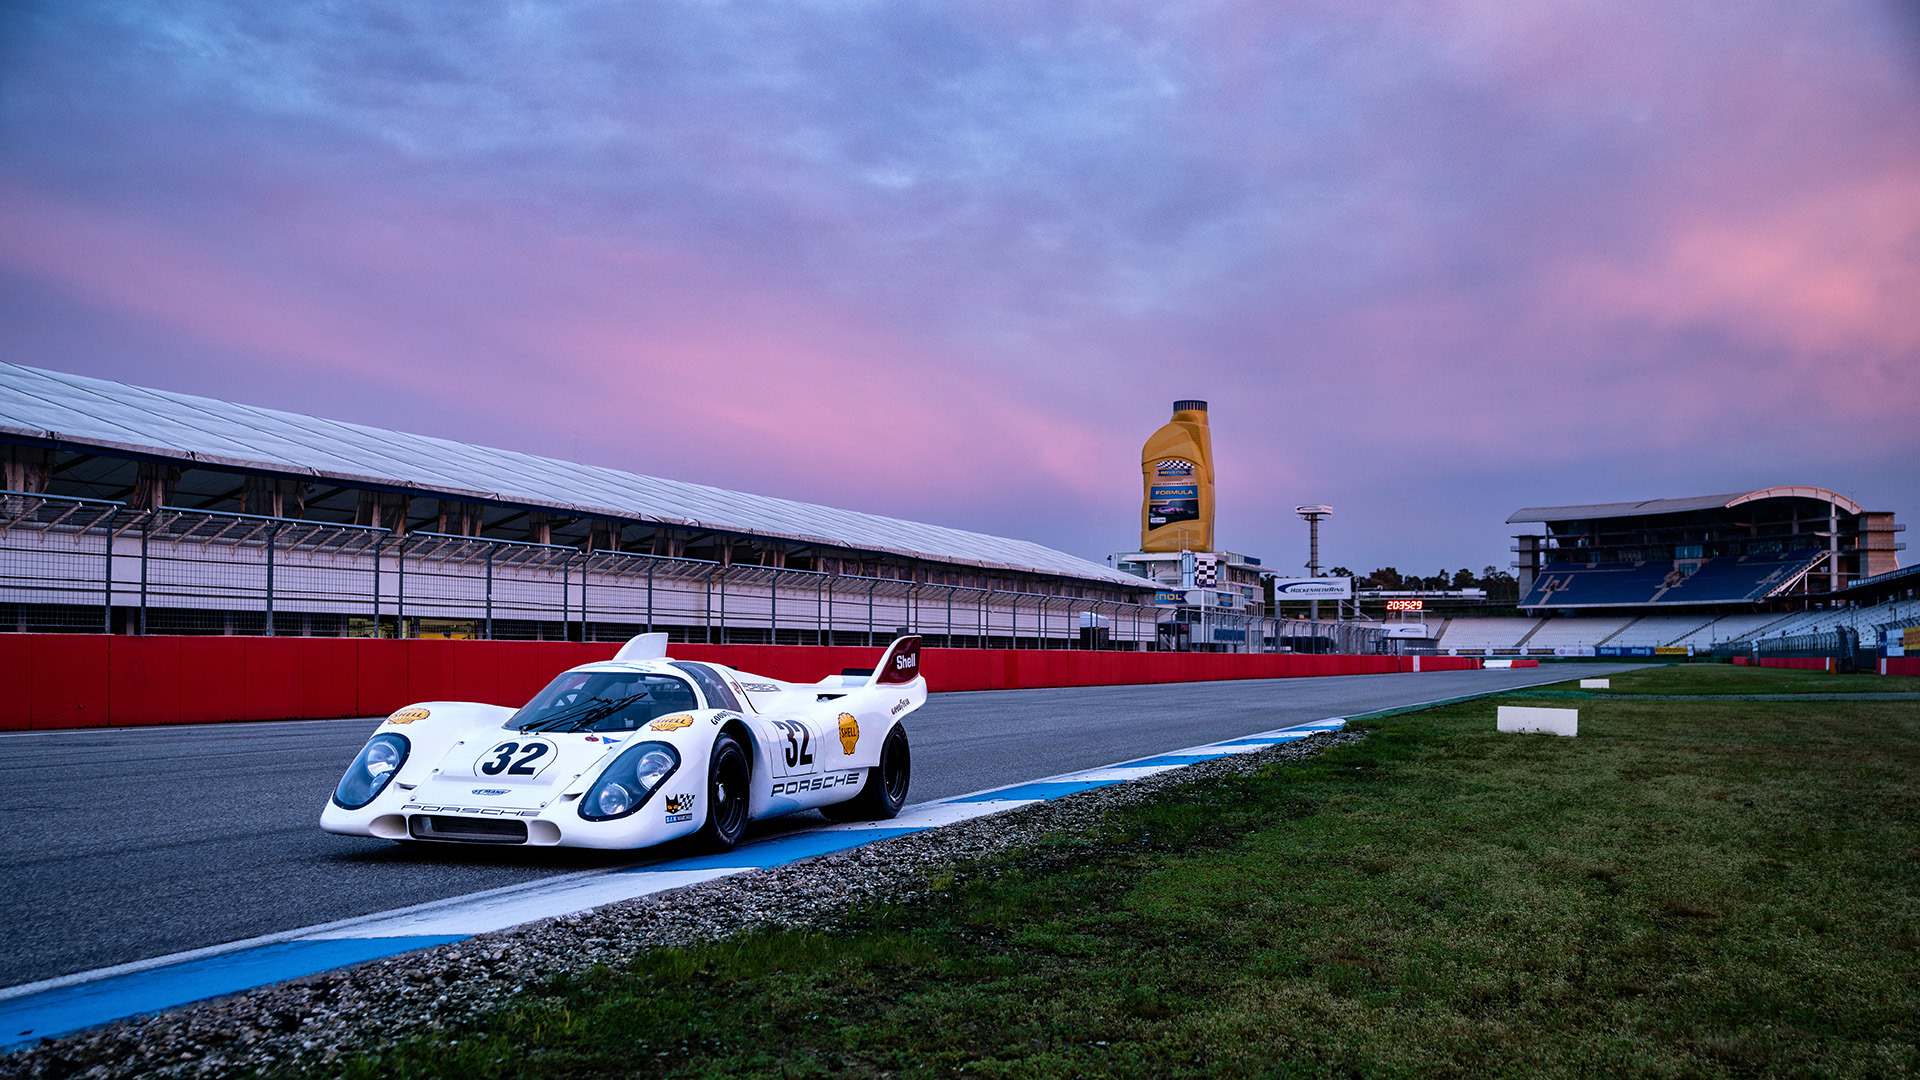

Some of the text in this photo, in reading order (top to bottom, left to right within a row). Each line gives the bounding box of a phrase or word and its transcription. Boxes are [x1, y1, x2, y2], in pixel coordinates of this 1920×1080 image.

[896, 653, 916, 669] Shell
[841, 727, 857, 738] SHELL
[771, 720, 813, 768] 32
[481, 742, 549, 776] 32
[771, 773, 860, 797] PORSCHE
[401, 804, 541, 817] PORSCHE
